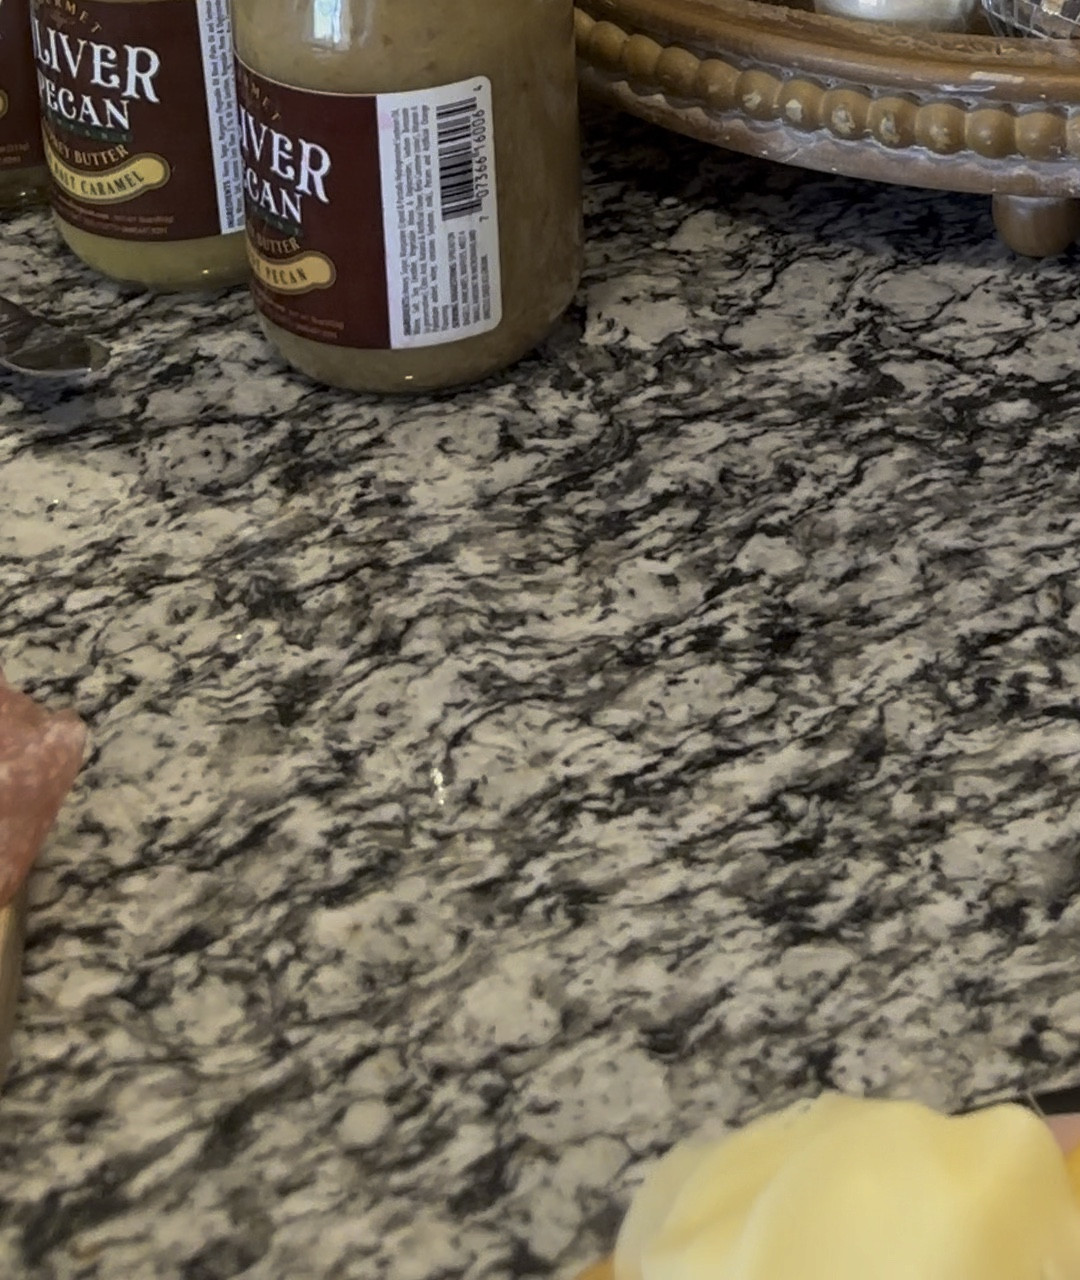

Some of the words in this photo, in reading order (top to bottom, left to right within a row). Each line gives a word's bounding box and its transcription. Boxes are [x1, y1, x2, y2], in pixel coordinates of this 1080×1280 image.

[33, 17, 161, 103] LIVER
[472, 109, 487, 152] 16006
[74, 144, 129, 166] BUTTER
[239, 104, 332, 204] IVER
[80, 170, 145, 196] CARAMEL
[245, 167, 302, 225] CAN
[473, 156, 489, 198] 07366
[265, 266, 308, 286] PECAN
